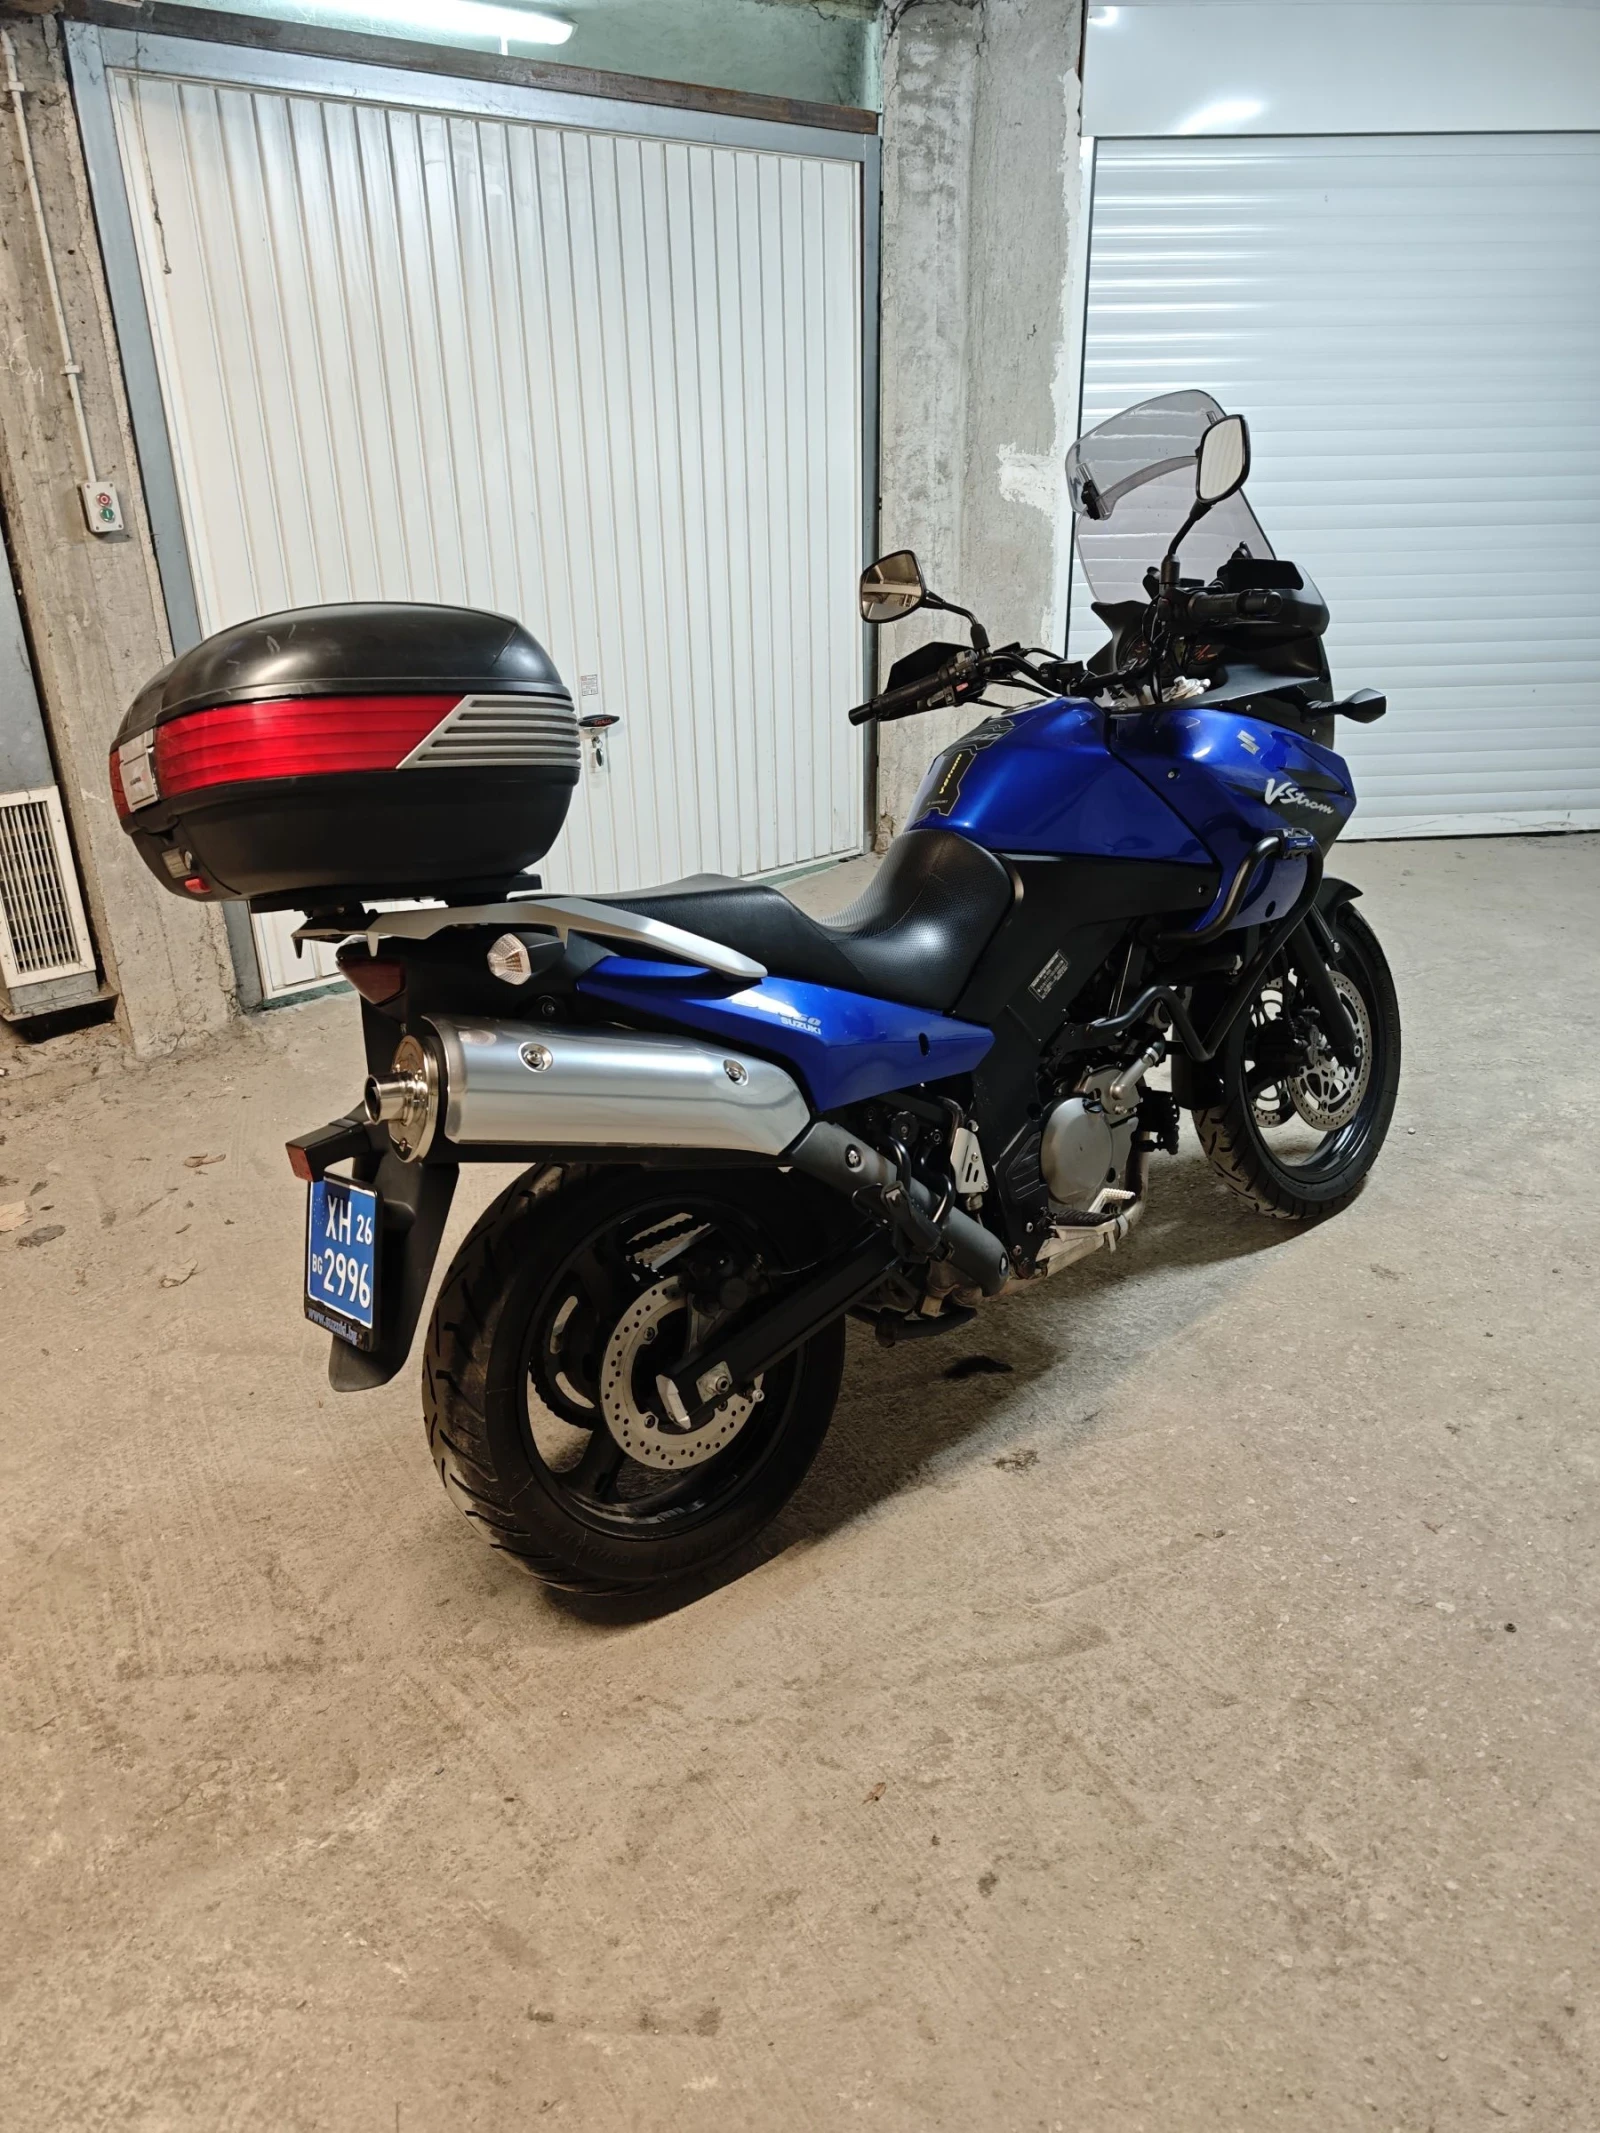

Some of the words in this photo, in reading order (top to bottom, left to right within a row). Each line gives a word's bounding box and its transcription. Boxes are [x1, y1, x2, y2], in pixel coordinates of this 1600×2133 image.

[1264, 778, 1335, 815] V-Strom
[780, 1016, 822, 1035] SUZUKI
[325, 1194, 352, 1246] XH
[356, 1214, 373, 1245] 26
[312, 1253, 323, 1275] BG
[323, 1248, 371, 1309] 2996
